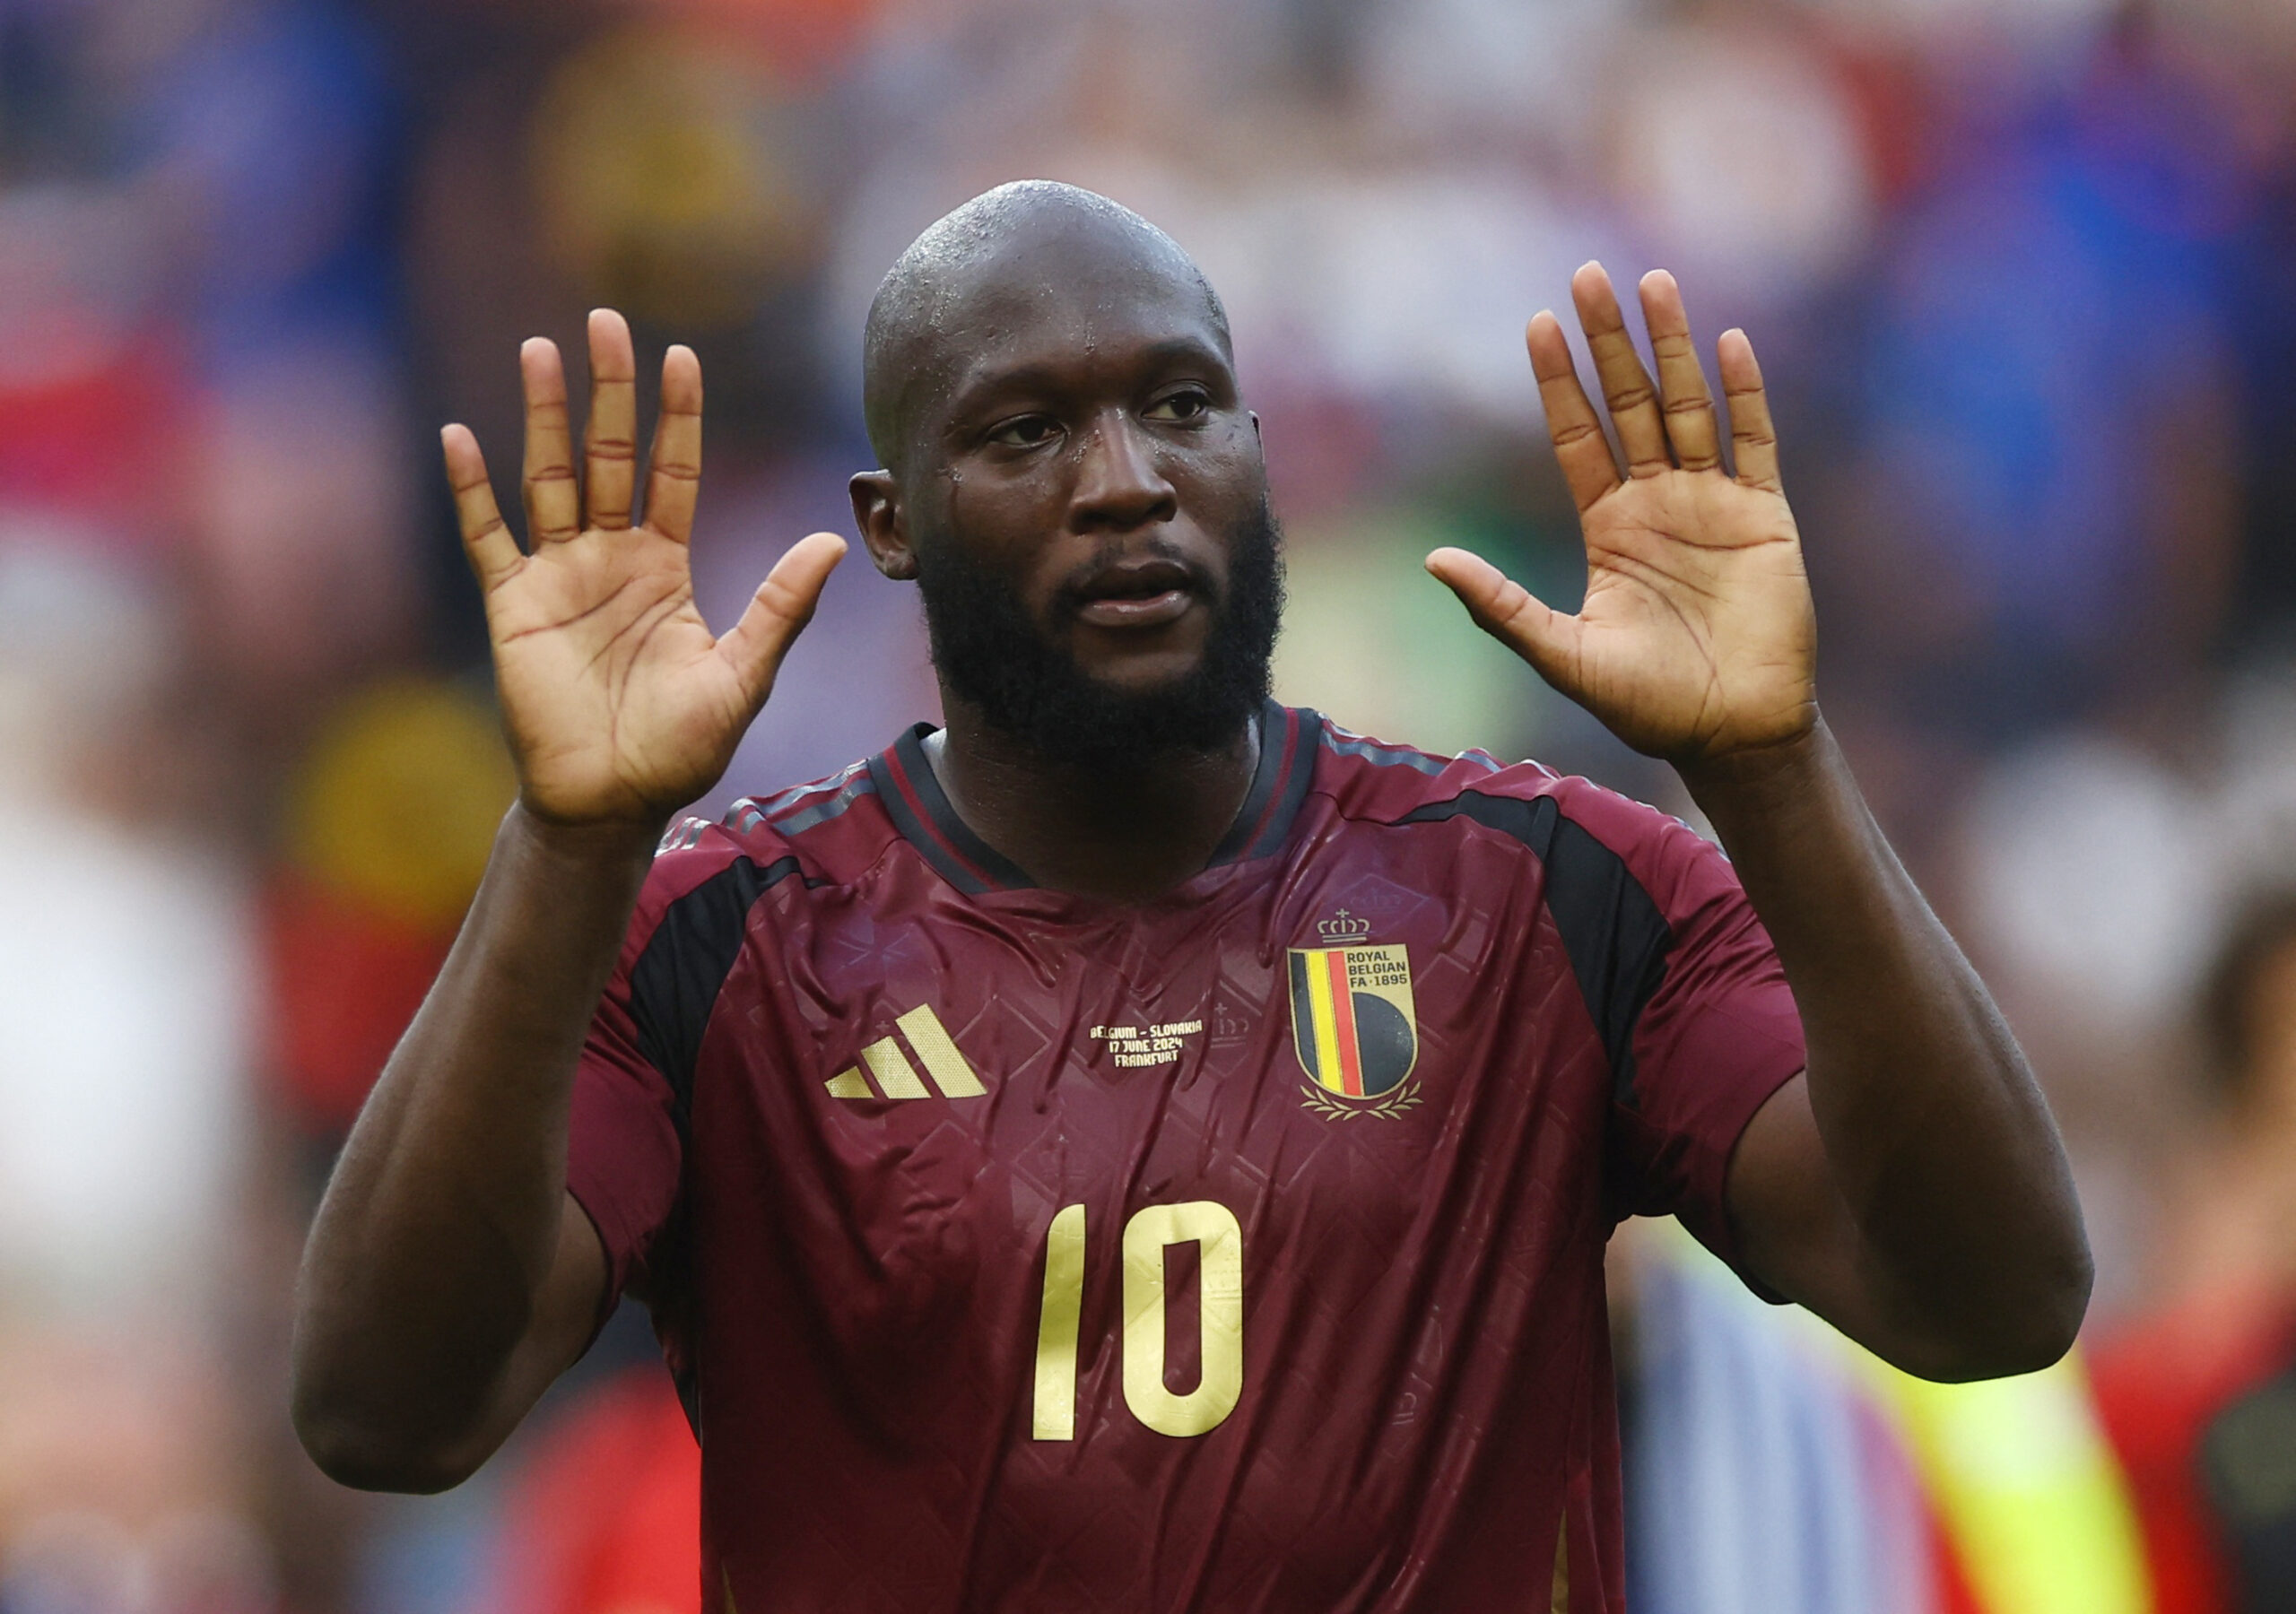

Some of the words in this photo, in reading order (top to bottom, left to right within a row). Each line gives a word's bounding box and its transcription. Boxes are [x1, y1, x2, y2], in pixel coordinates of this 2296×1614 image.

[1347, 950, 1389, 963] ROYAL
[1348, 961, 1406, 976] BELGIAN
[1090, 1026, 1137, 1039] BELGIUM
[1149, 1020, 1203, 1037] SLOVAKIA
[1109, 1041, 1119, 1053] 17
[1122, 1040, 1150, 1053] JUNE
[1152, 1037, 1183, 1052] 2024
[1115, 1049, 1178, 1067] FRANKFURT
[1032, 1200, 1244, 1441] 10
